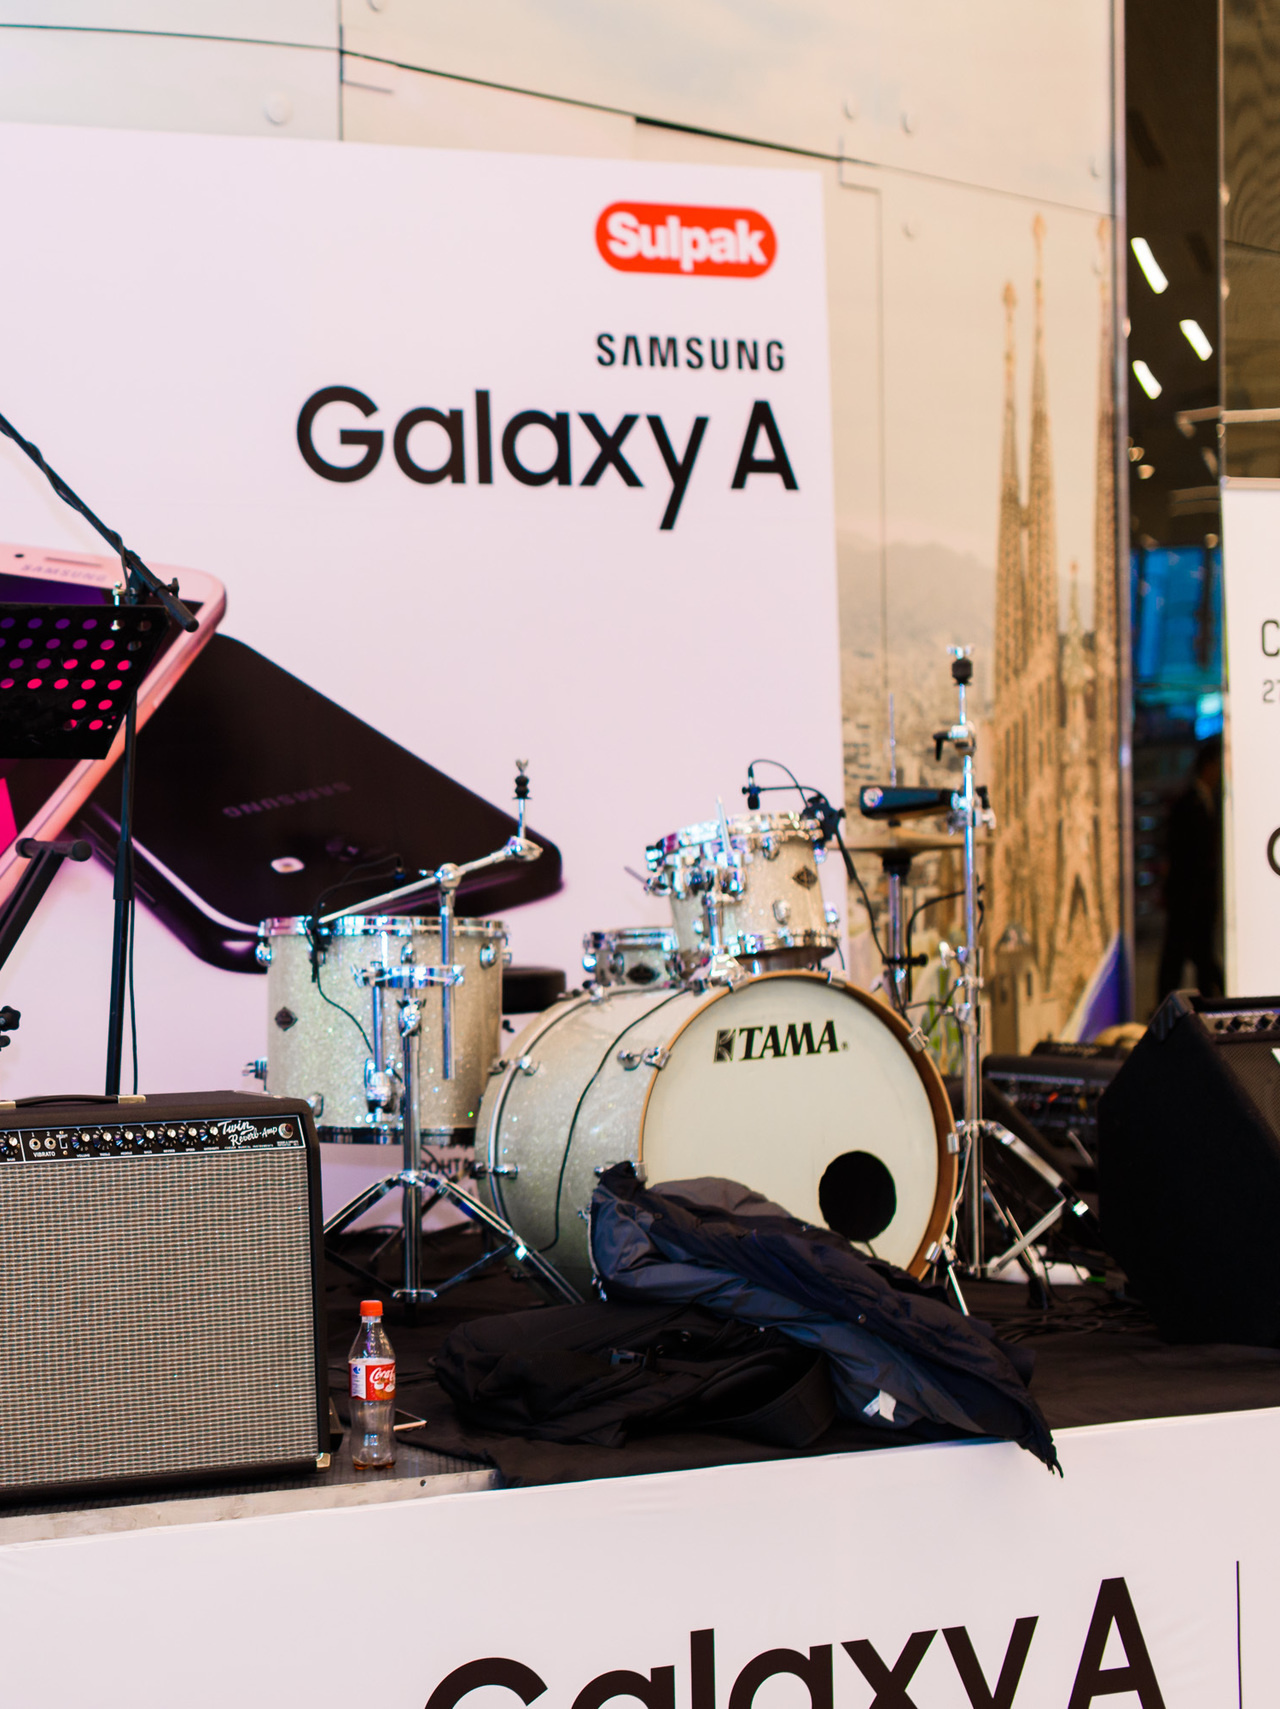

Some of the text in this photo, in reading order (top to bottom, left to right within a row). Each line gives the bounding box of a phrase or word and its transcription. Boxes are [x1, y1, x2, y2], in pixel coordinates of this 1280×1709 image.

[606, 211, 768, 273] Sulpak
[596, 333, 786, 372] SAMSUNG
[296, 385, 800, 530] Galaxy A
[738, 1020, 839, 1062] TAMA
[217, 1120, 255, 1136] Twin
[1067, 1576, 1167, 1709] A
